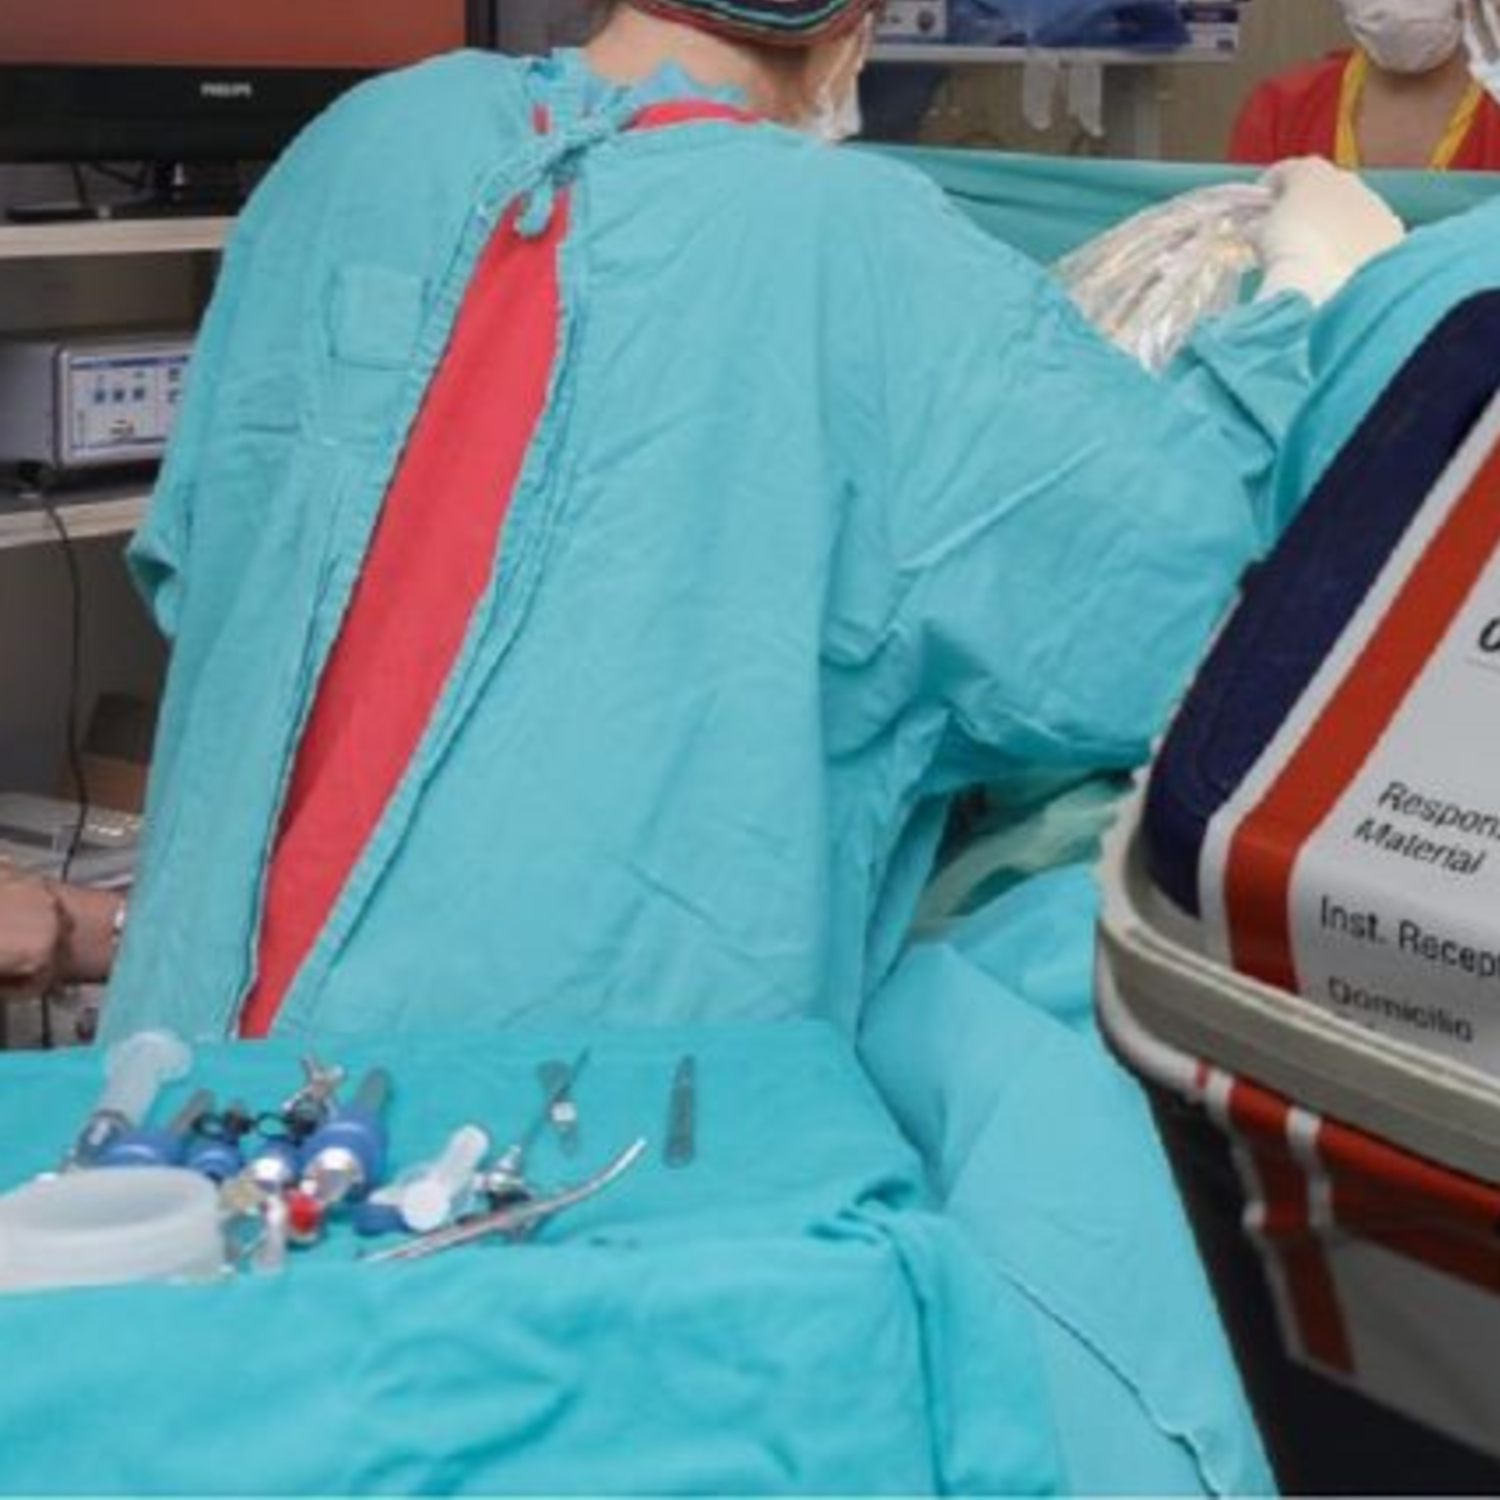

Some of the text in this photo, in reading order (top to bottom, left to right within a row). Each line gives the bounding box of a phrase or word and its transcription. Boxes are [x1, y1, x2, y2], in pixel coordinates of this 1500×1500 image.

[1355, 817, 1486, 875] Material
[1320, 894, 1387, 944] Inst.
[1327, 976, 1473, 1043] Domicilio
